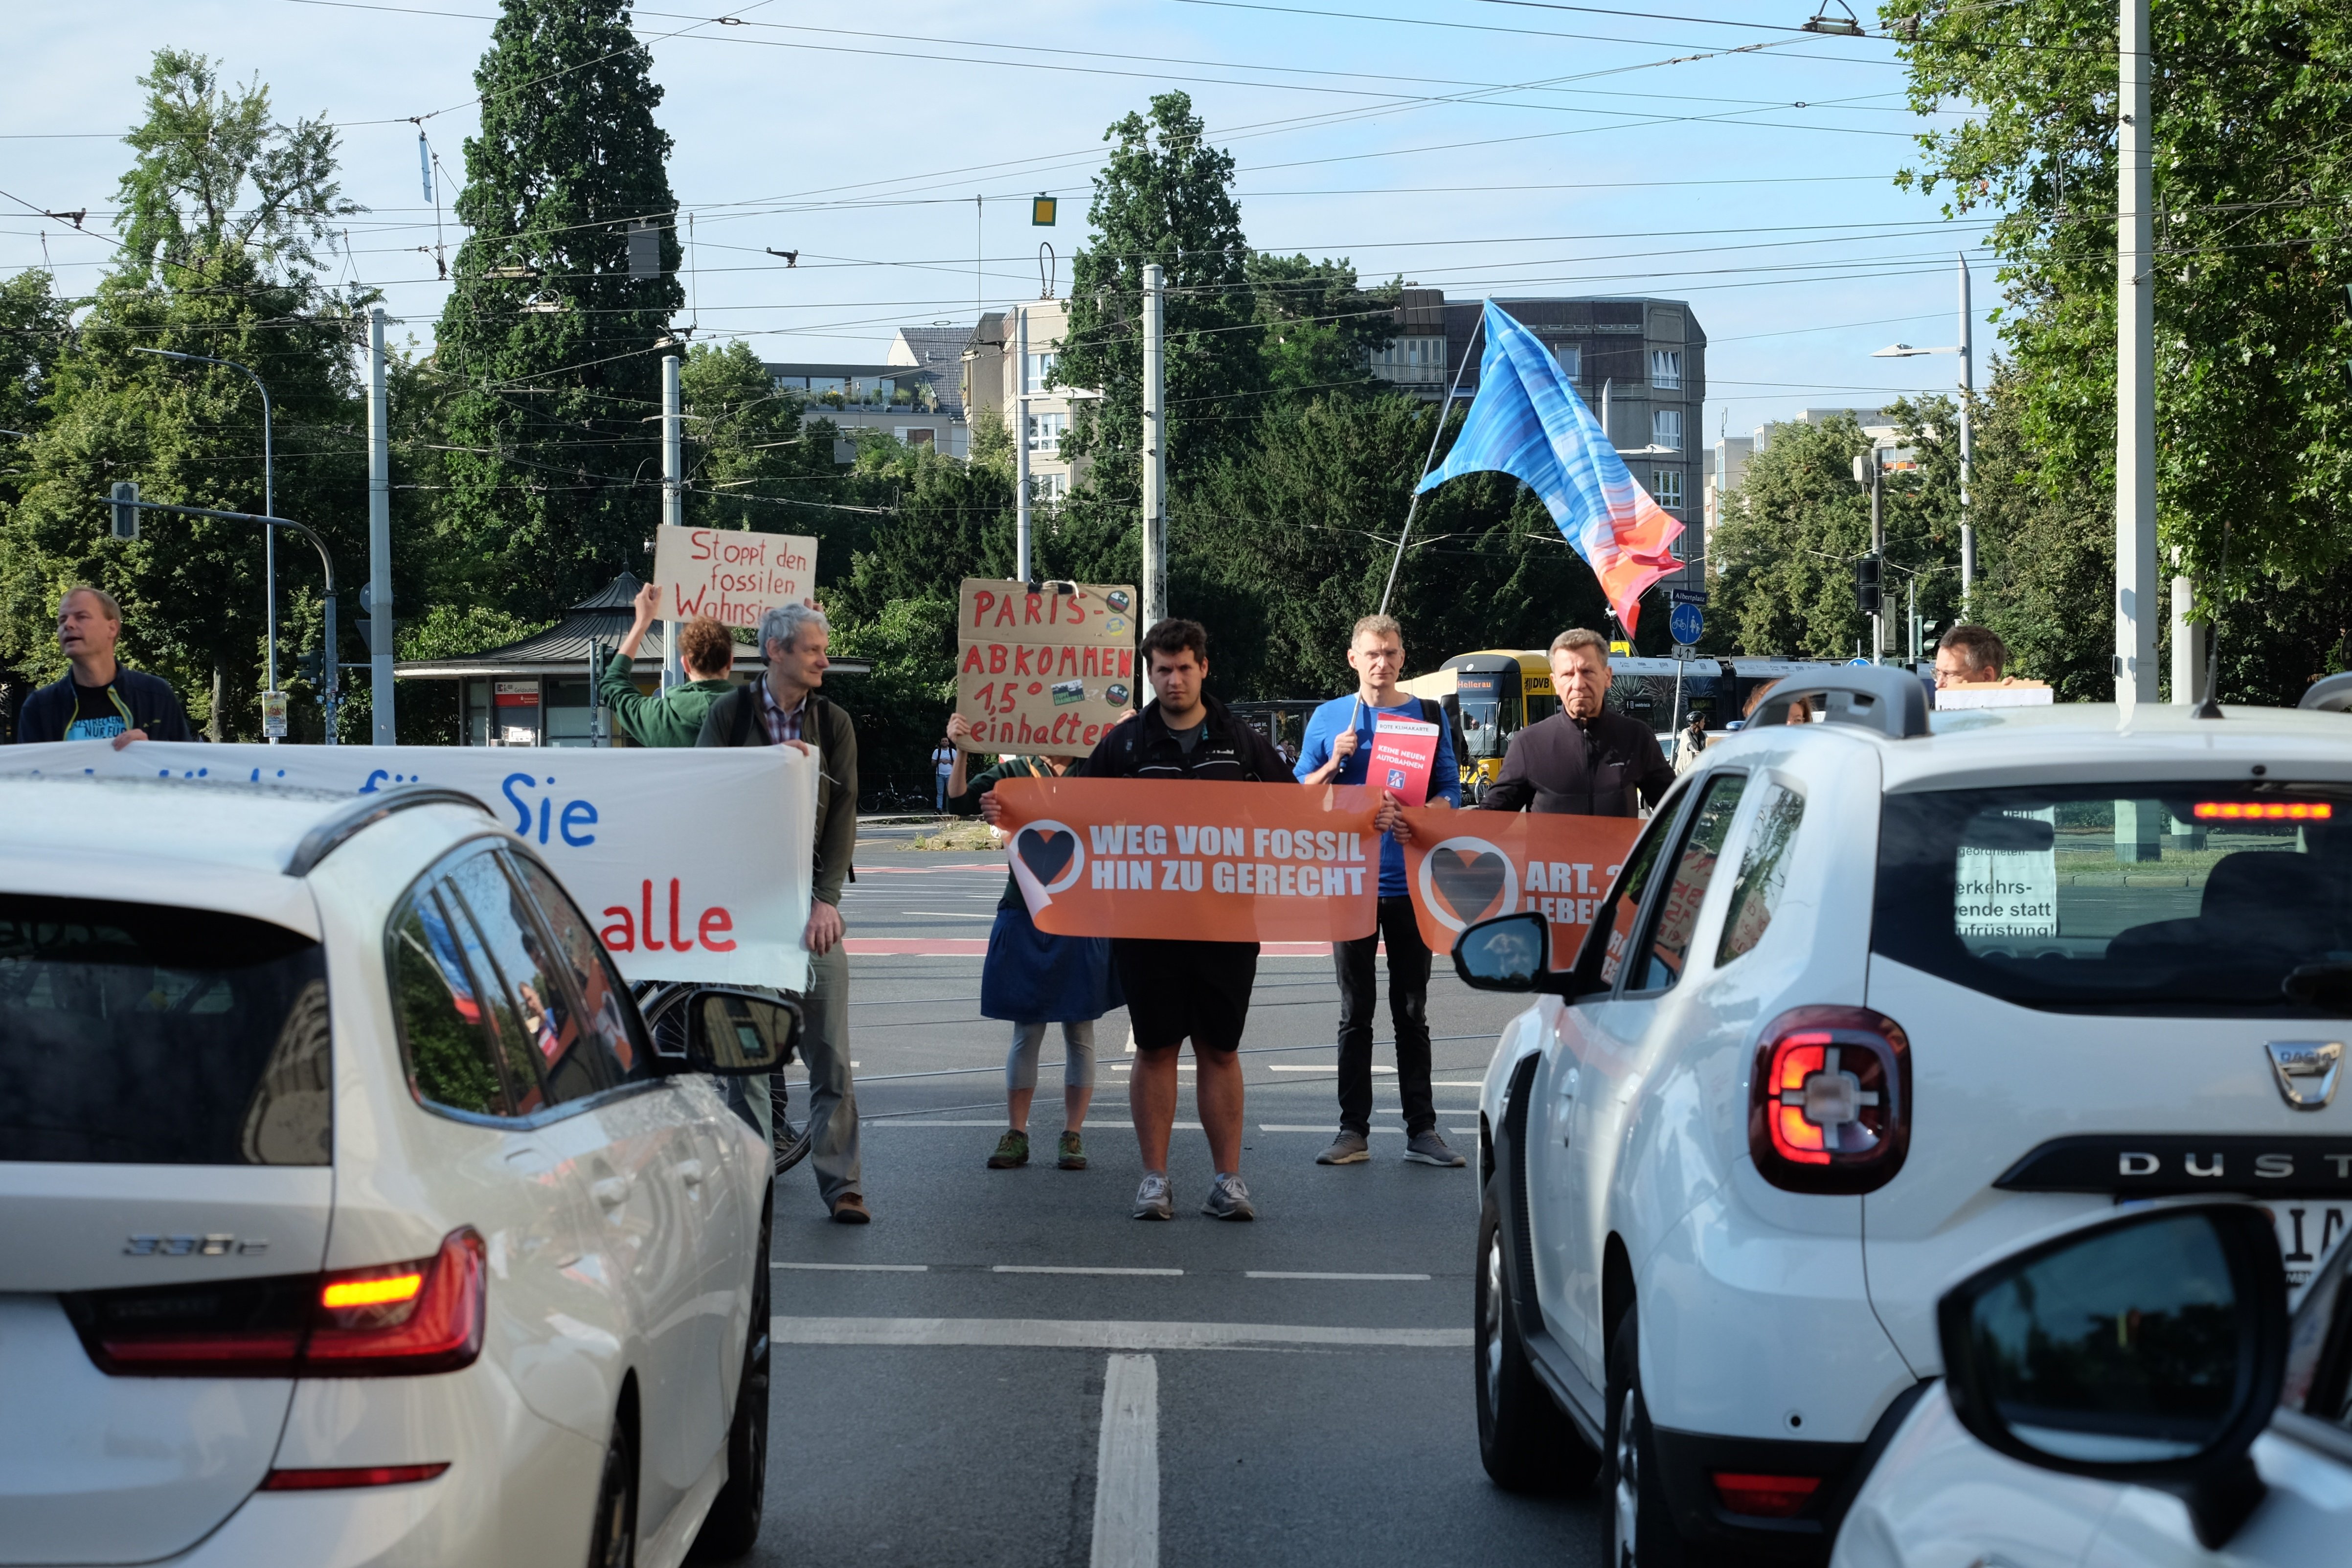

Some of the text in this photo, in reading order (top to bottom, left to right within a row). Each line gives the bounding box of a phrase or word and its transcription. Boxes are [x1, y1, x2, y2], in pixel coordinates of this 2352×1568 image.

[691, 531, 807, 571] Stoppt den
[711, 563, 795, 594] fossilen
[676, 582, 775, 625] Wahnsi
[973, 591, 1104, 628] PARIS-
[1675, 592, 1705, 602] Albertplatz
[962, 644, 1133, 679] ABKOMMEN
[973, 682, 1043, 716] 1,5°
[1533, 678, 1550, 688] DVB
[1376, 754, 1424, 770] AUTOBAHNEN
[1378, 745, 1426, 762] KEINE NEUEN
[501, 772, 598, 847] Sie
[1088, 825, 1365, 862] WEG VON FOSSIL
[1091, 860, 1367, 896] HIN ZU GERECHT
[1525, 861, 1598, 894] ART.
[1957, 879, 2032, 894] erkehrs-
[600, 877, 737, 953] alle
[1958, 902, 2051, 917] ende statt
[1958, 923, 2054, 938] ufrüstung!
[2280, 1050, 2332, 1064] DACIA
